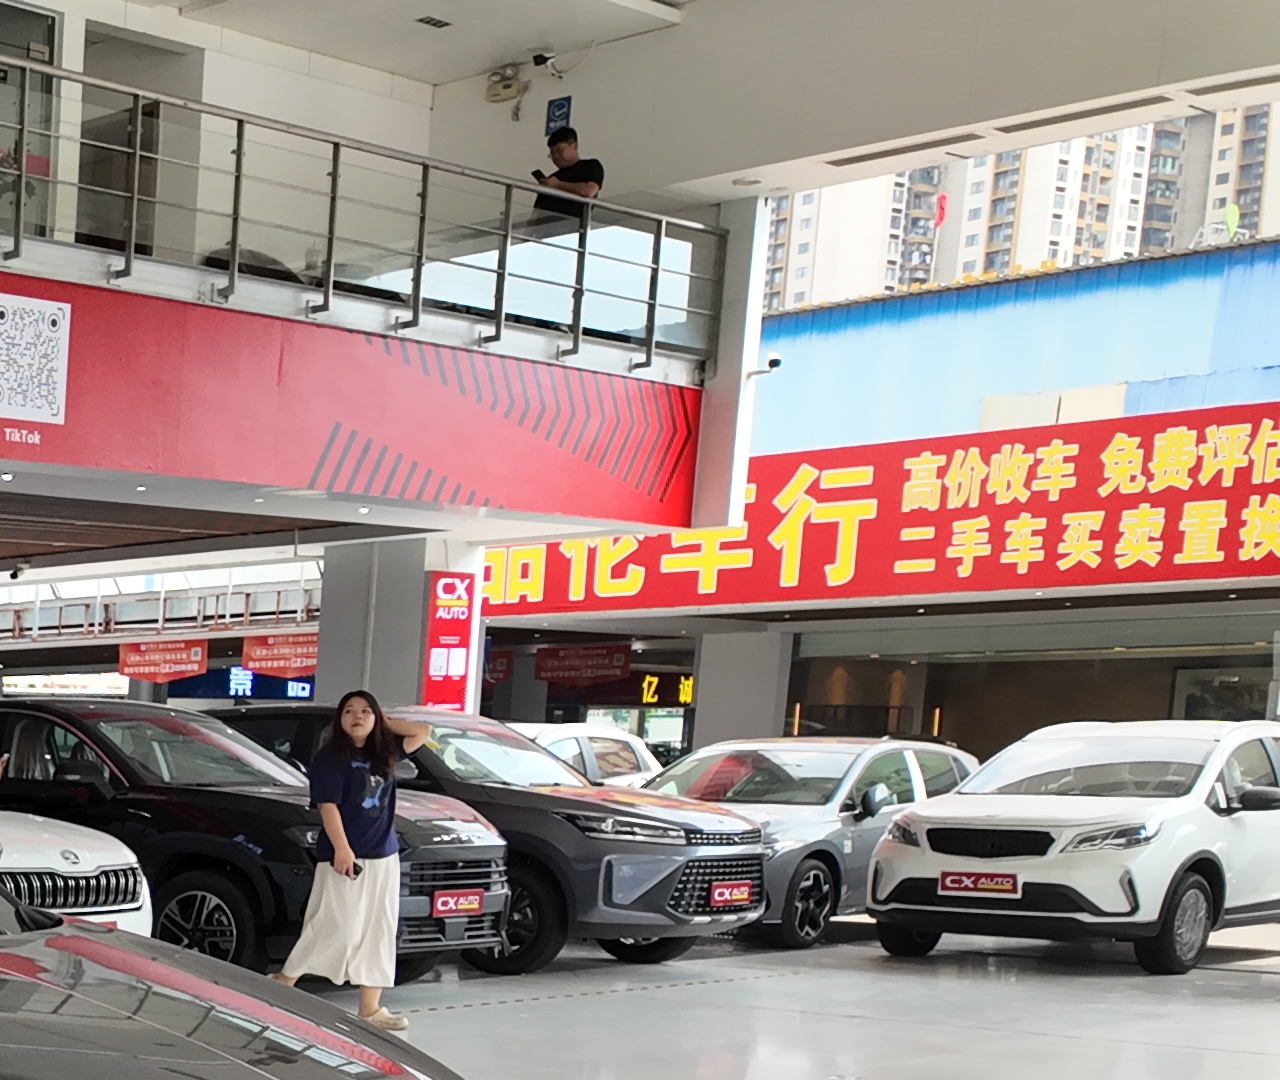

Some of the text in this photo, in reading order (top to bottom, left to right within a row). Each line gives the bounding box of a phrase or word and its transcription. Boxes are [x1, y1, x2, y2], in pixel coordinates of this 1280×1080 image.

[4, 427, 41, 445] TikTok
[901, 418, 1280, 513] 高价收车 免费评估
[893, 492, 1280, 578] 二手车买卖置换
[436, 577, 470, 600] CX
[436, 607, 469, 620] AUTO
[944, 875, 1013, 888] CX AUTO
[437, 895, 480, 911] CX AUTO
[714, 888, 732, 901] CX
